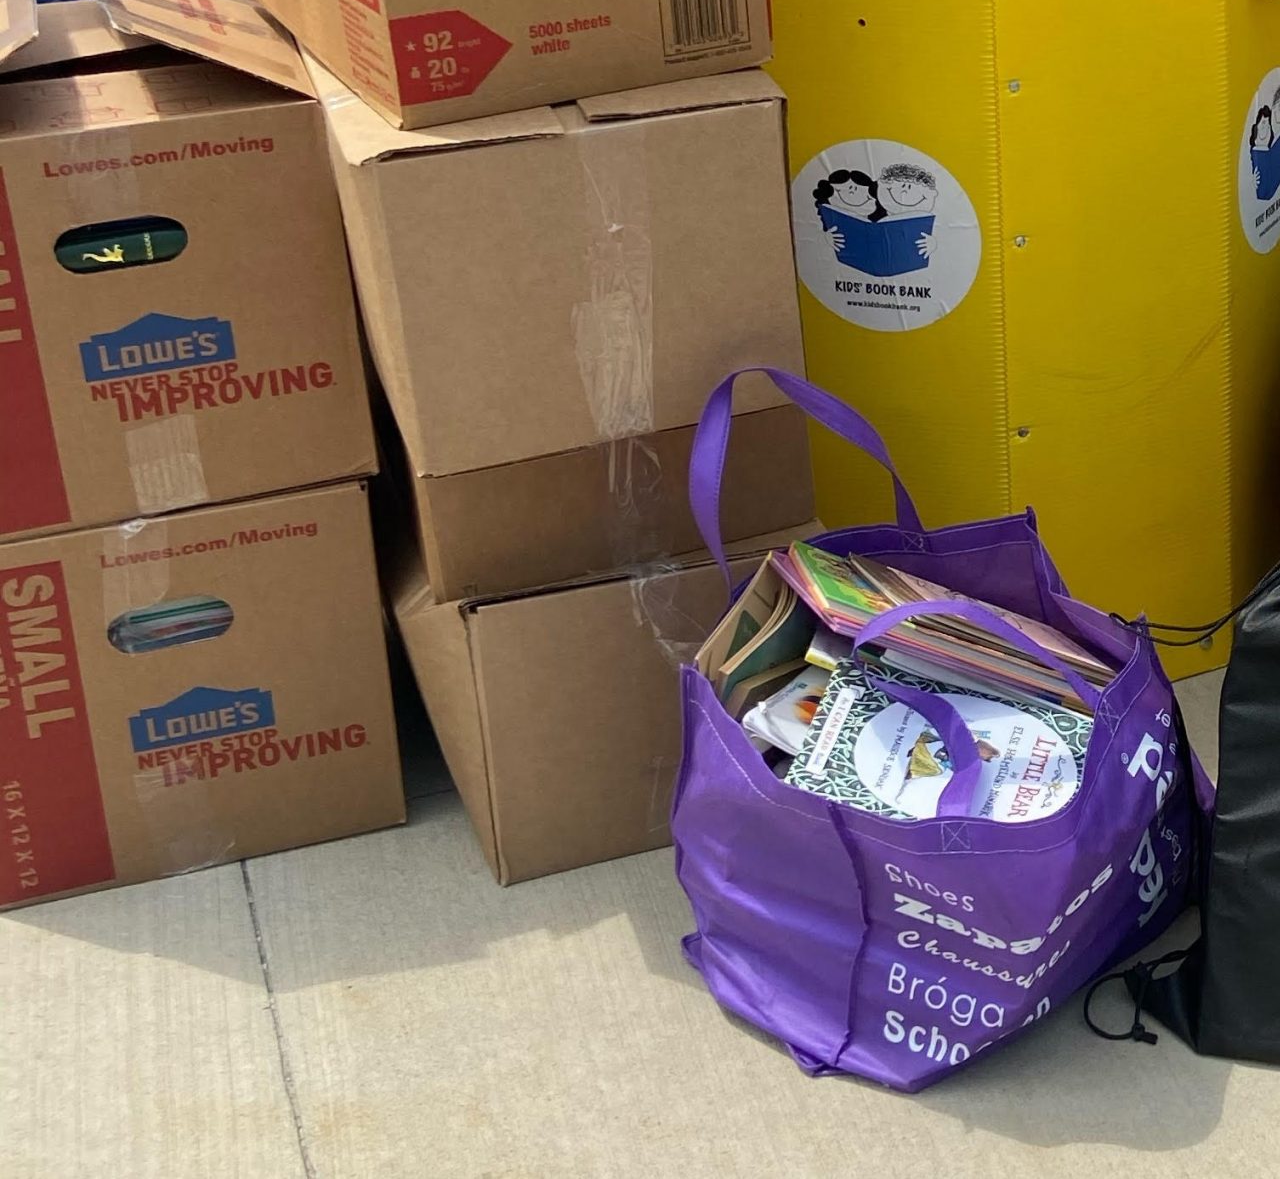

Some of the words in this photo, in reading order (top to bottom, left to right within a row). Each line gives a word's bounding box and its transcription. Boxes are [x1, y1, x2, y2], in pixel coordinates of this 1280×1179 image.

[424, 31, 453, 52] 92
[529, 21, 563, 39] 5000
[566, 15, 612, 33] sheets
[531, 38, 570, 56] white
[428, 57, 457, 79] 20
[43, 136, 275, 179] Lowes.com/Moving
[865, 282, 897, 297] BOOK
[899, 285, 932, 299] BANK
[98, 331, 219, 373] LOWE'S
[90, 373, 172, 403] NEVER
[179, 362, 239, 387] STOP
[117, 361, 335, 423] IMPROVING
[101, 522, 319, 570] Lowes.com/Moving
[1, 574, 77, 740] SMALL
[146, 701, 260, 744] LOWE'S
[137, 742, 215, 771] NEVER
[220, 728, 279, 751] STOP
[163, 722, 367, 788] IMPROVING
[1021, 734, 1058, 782] LITTLE
[2, 780, 23, 803] 16
[7, 805, 27, 820] X
[1007, 785, 1041, 817] BEAR
[11, 823, 31, 847] 12
[15, 847, 34, 865] X
[21, 866, 39, 889] 12
[885, 863, 975, 913] Shoes
[893, 863, 1113, 956] Zapatos
[897, 930, 1071, 989] Chaussures
[888, 962, 1004, 1028] Bróga
